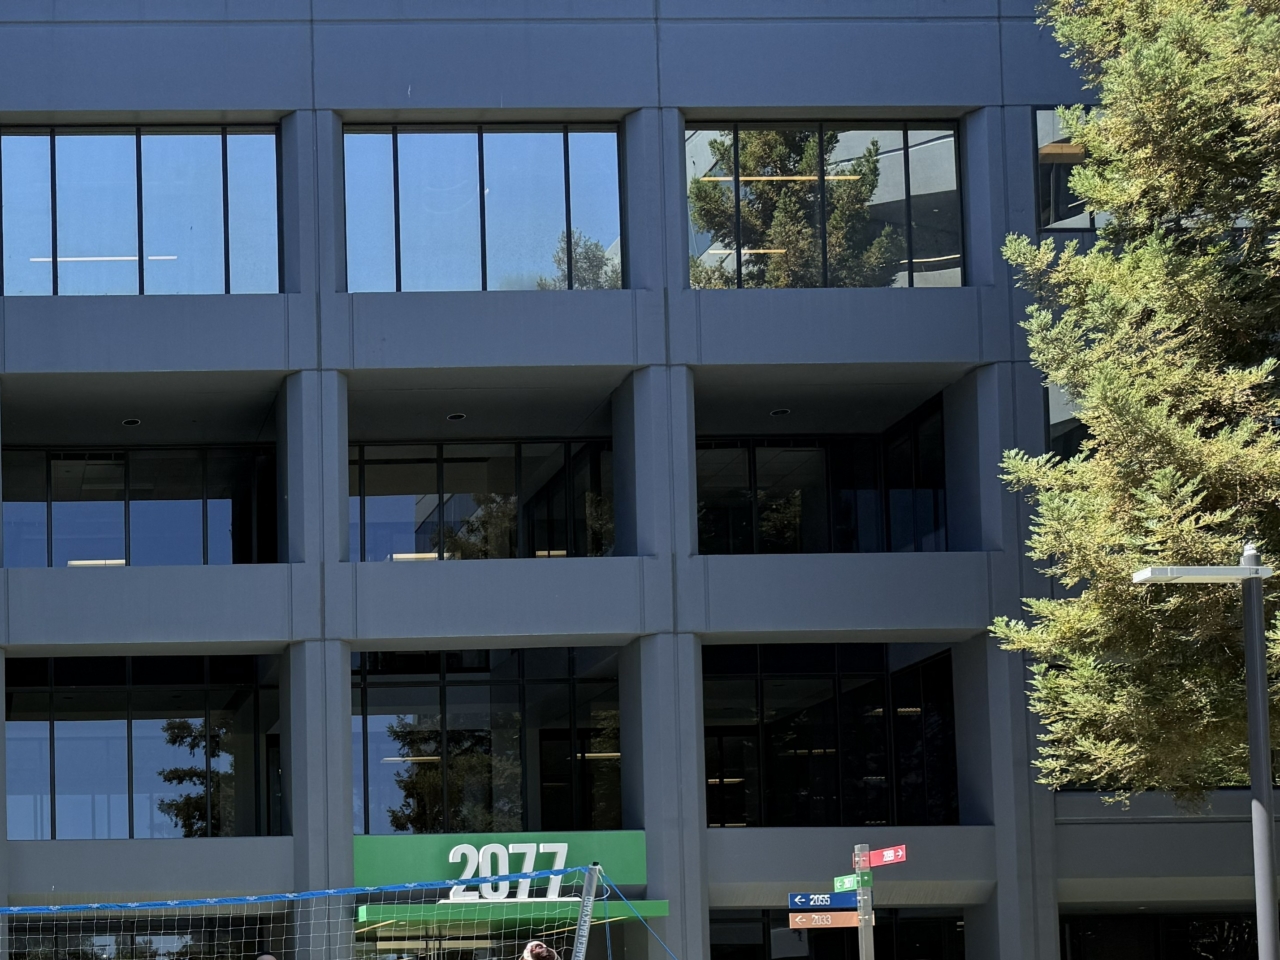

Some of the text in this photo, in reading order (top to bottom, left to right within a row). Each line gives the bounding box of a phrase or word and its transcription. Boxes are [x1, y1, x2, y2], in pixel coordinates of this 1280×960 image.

[449, 843, 568, 899] 2077
[809, 895, 830, 905] 2055
[580, 896, 592, 935] BACKYARD
[811, 915, 831, 925] 2033
